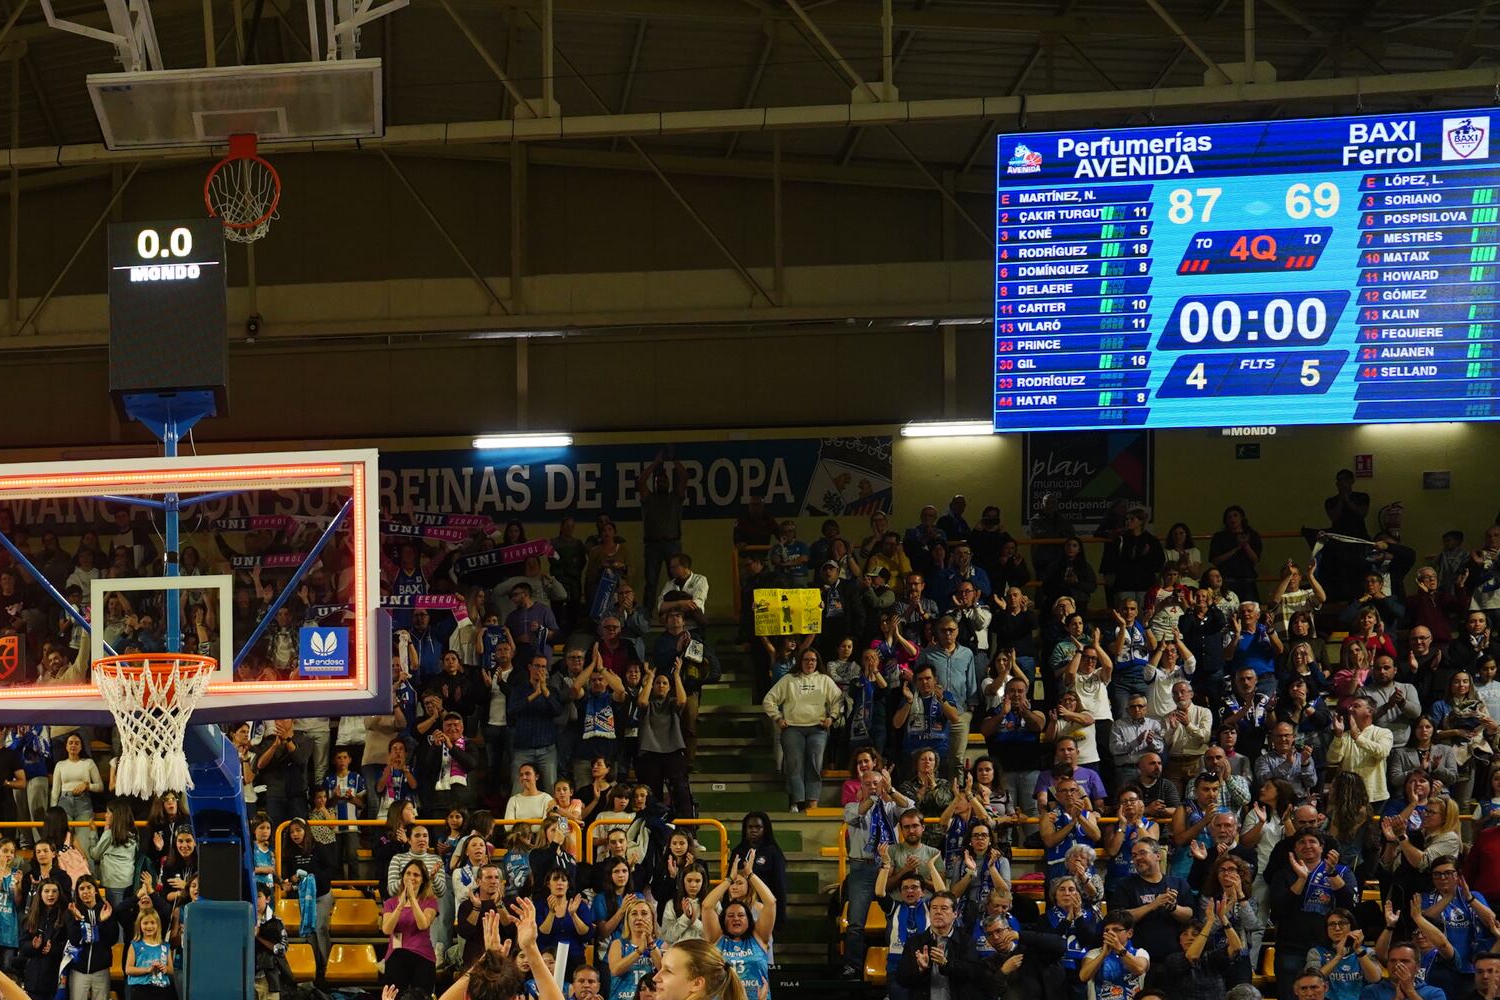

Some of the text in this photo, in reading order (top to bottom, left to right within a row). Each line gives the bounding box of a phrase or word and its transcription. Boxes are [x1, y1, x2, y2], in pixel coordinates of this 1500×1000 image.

[1350, 121, 1416, 144] BAXI
[1454, 134, 1478, 143] BAXI
[1058, 132, 1211, 158] Perfumerías
[1343, 144, 1421, 165] Ferrol
[1007, 166, 1041, 174] AVENIDA
[1074, 155, 1194, 178] AVENIDA
[1366, 174, 1443, 188] E LÓPEZ, L.
[1002, 191, 1096, 204] E MARTÍNEZ, N.
[1285, 182, 1340, 219] 69
[1367, 194, 1441, 206] 3 SORIANO
[1168, 188, 1222, 224] 87
[1002, 207, 1147, 223] 2 ÇAKIR TURGUT 11
[1384, 212, 1467, 224] POSPISILOVA
[1002, 225, 1147, 241] 3 KONÉ 5
[1304, 234, 1321, 244] TO
[1366, 232, 1443, 244] 7 MESTRES
[138, 228, 192, 258] 0.0
[1196, 239, 1212, 248] TO
[1230, 235, 1277, 261] 4Q
[1001, 244, 1147, 259] 4 RODRÍGUEZ 18
[1366, 252, 1429, 263] 10 MATAIX
[131, 265, 200, 281] MONDO
[1001, 262, 1147, 277] 6 DOMÍNGUEZ 8
[1365, 271, 1438, 282] 11 HOWARD
[1001, 284, 1073, 296] 8 DELAERE
[1365, 288, 1426, 301] 12 GÓMEZ
[1000, 300, 1146, 314] 11 CARTER 10
[1180, 298, 1326, 343] 00:00
[1365, 310, 1419, 320] 13 KALIN
[1000, 319, 1145, 333] 13 VILARÓ 11
[1382, 328, 1443, 339] FEQUIERE
[1000, 340, 1060, 351] 23 PRINCE
[1364, 347, 1434, 358] 21 AIJANEN
[1018, 359, 1036, 369] GIL
[1131, 355, 1145, 365] 16
[1240, 359, 1275, 369] FLTS
[1186, 363, 1207, 389] 4
[1300, 360, 1320, 386] 5
[1381, 366, 1437, 377] SELLAND
[1017, 375, 1085, 387] RODRÍGUEZ
[1017, 396, 1057, 406] HATAR
[1137, 393, 1145, 402] 8
[1231, 427, 1276, 435] MONDO
[1029, 451, 1096, 485] plan
[545, 464, 603, 511] DE
[1033, 479, 1082, 489] municipal
[388, 523, 420, 535] UNI
[466, 552, 497, 568] UNI
